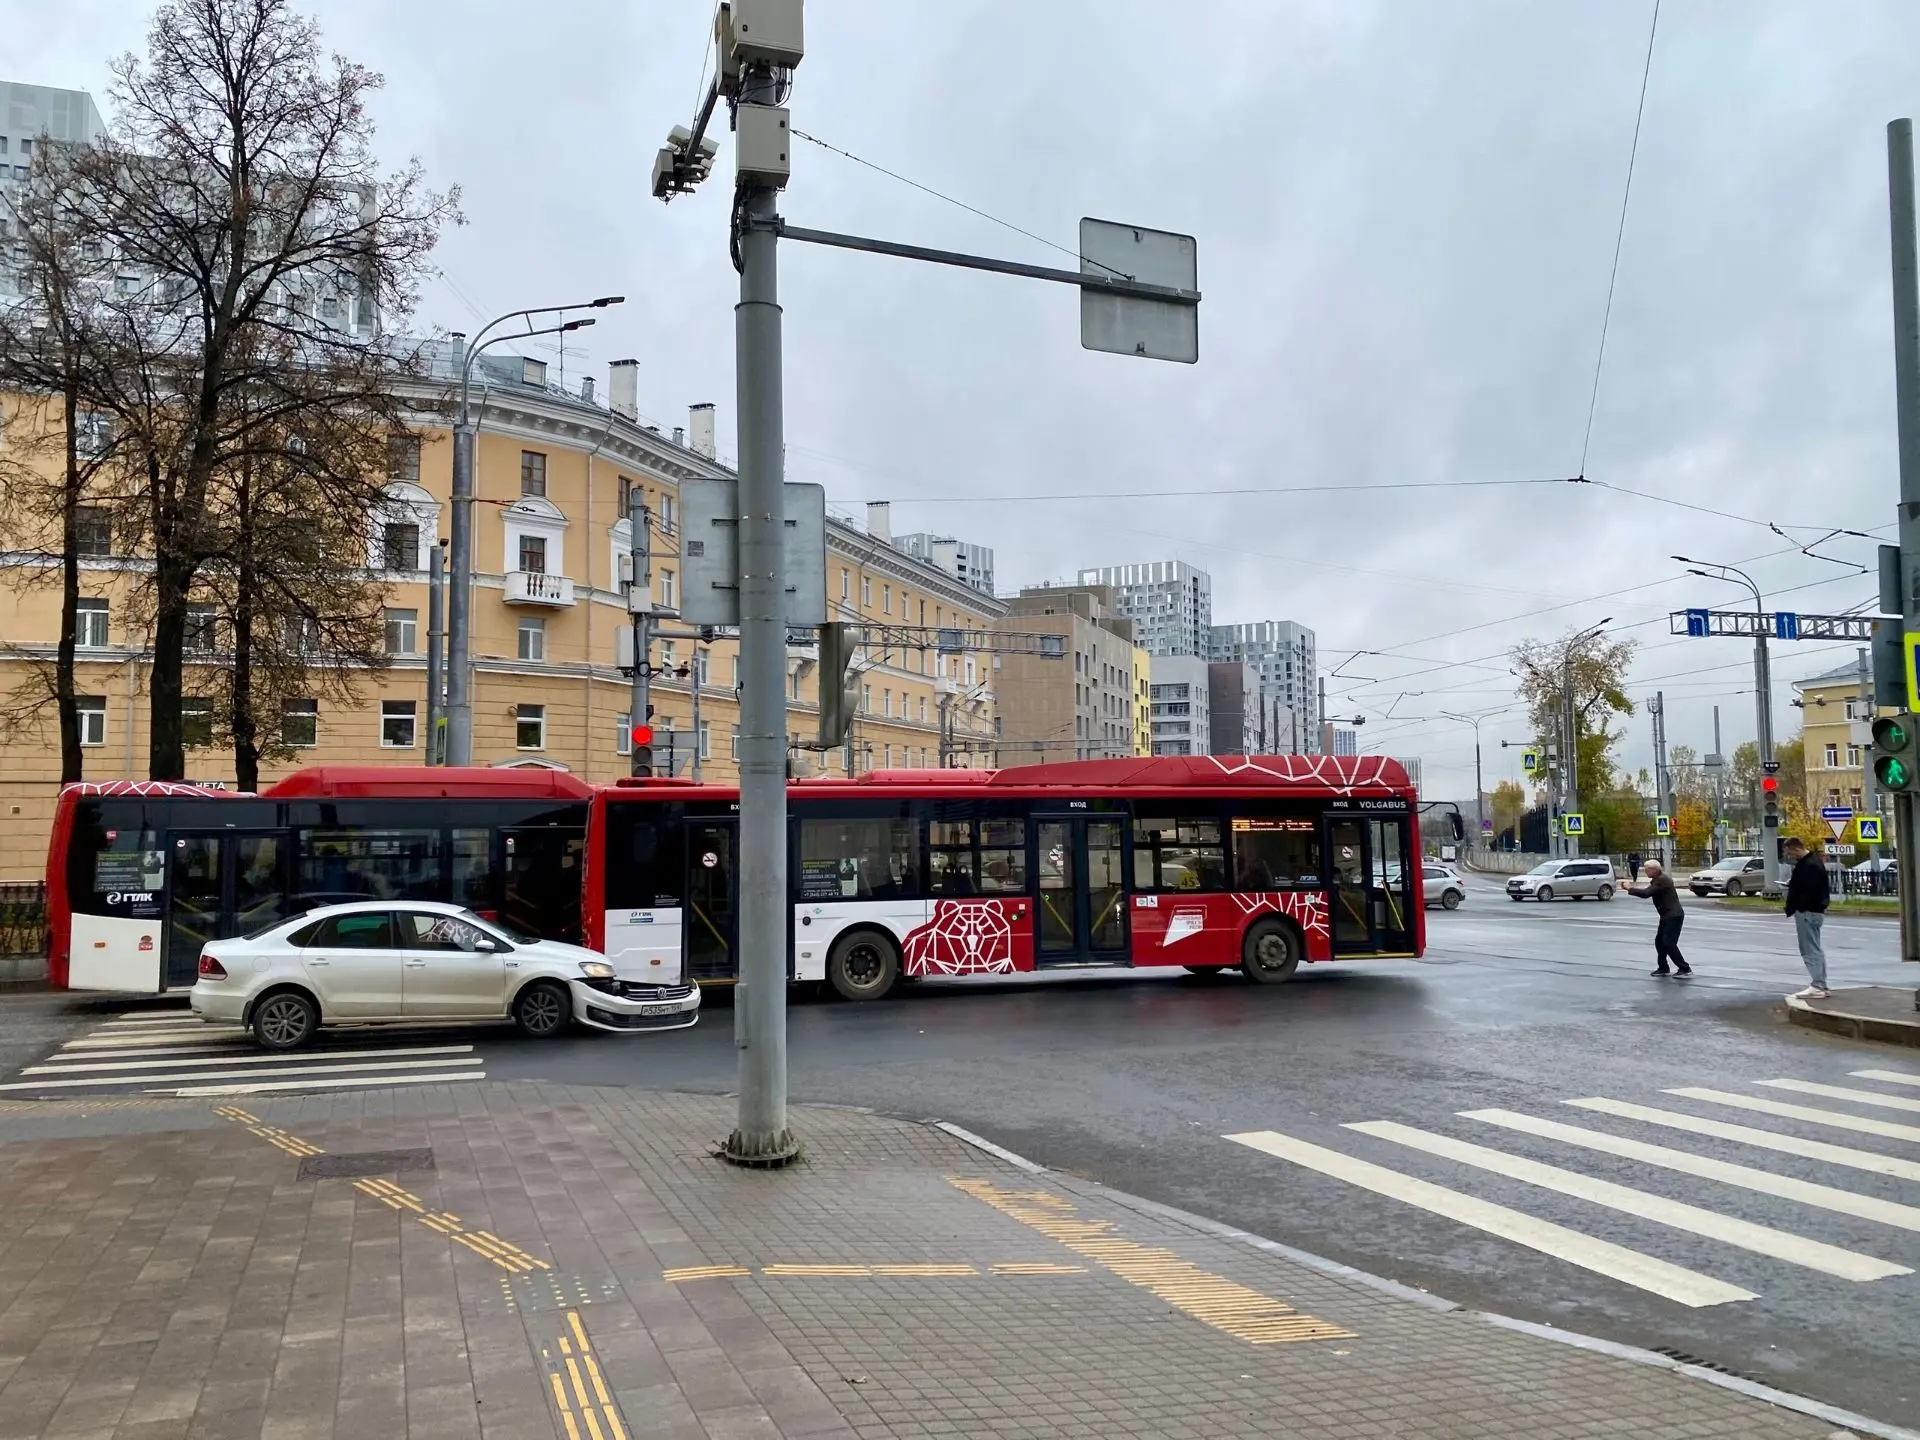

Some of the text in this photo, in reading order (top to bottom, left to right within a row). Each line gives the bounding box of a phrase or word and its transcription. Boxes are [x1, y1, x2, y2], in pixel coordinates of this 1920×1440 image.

[195, 782, 226, 790] НЕТА
[1069, 801, 1087, 809] ВХОД
[1359, 801, 1407, 809] VOLGABUS
[1827, 845, 1852, 853] СТОП
[123, 893, 153, 902] ГТЛК
